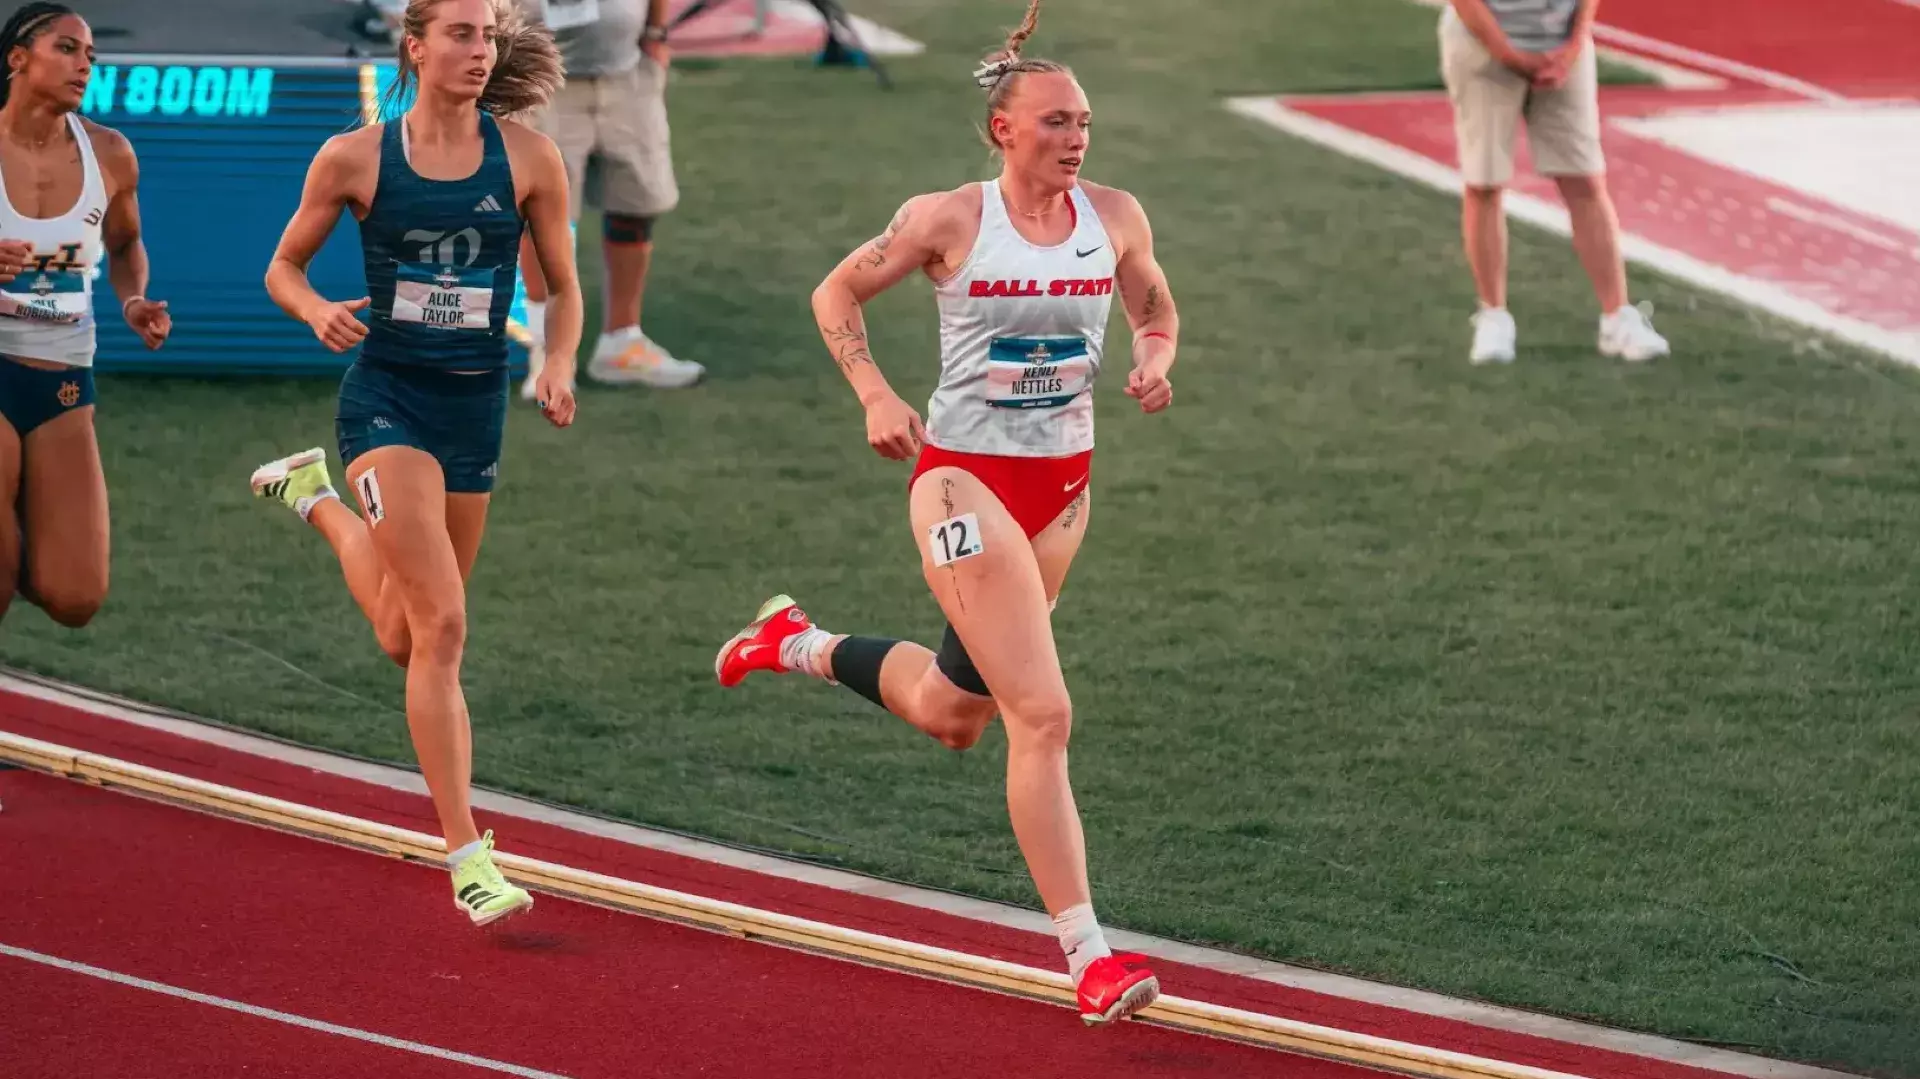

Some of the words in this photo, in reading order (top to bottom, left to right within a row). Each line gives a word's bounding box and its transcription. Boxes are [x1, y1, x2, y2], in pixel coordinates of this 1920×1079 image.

[124, 65, 274, 116] 800M
[968, 279, 1044, 297] BALL
[428, 292, 462, 307] ALICE
[422, 307, 465, 324] TAYLOR
[1023, 366, 1058, 379] KENLI
[1012, 378, 1063, 395] NETTLES
[364, 476, 378, 519] 4
[937, 520, 973, 561] 12
